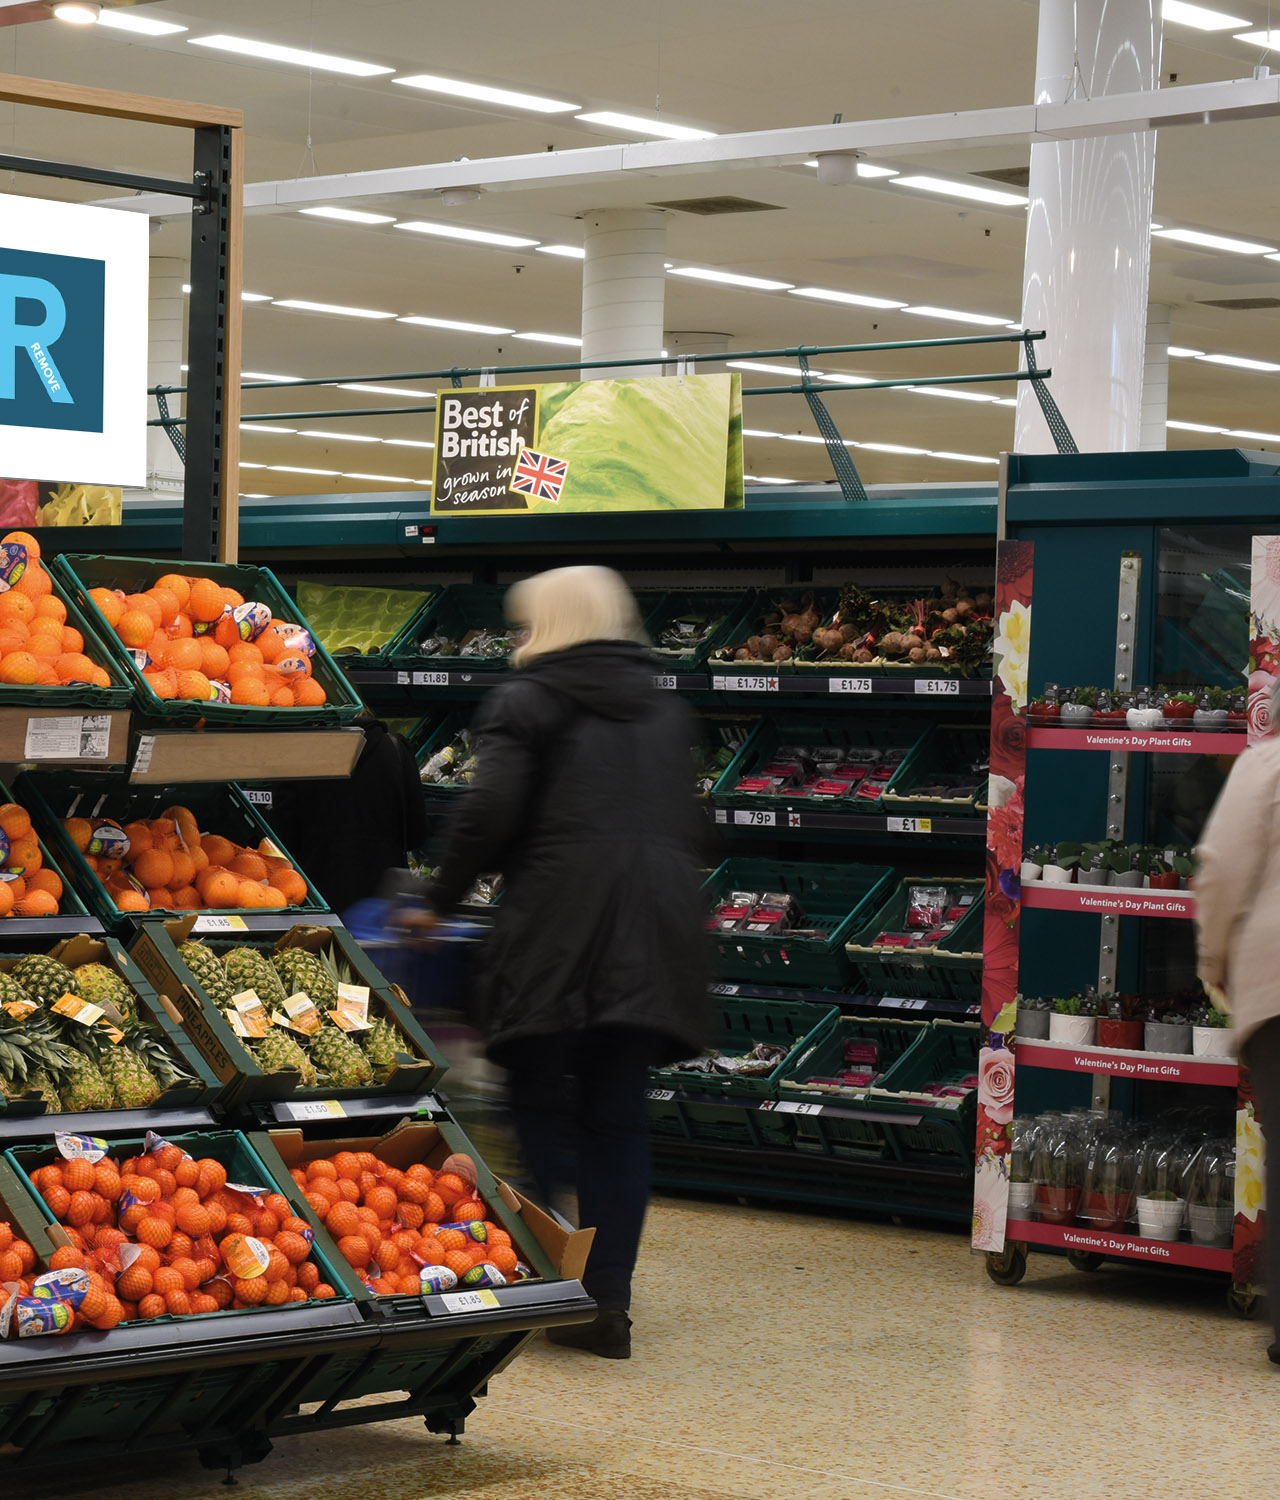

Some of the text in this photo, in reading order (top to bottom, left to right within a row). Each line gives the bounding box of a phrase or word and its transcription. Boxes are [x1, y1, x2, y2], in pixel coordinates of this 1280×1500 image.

[30, 341, 61, 393] REMOVE
[443, 397, 530, 429] Best of
[442, 428, 526, 458] British
[437, 465, 512, 502] grown in
[453, 485, 507, 505] season
[423, 673, 447, 683] £1.89
[654, 677, 675, 687] 1.85
[737, 678, 765, 688] £1.75
[841, 680, 870, 691] £1.75
[927, 681, 957, 692] £1.75
[1086, 735, 1192, 747] Valentine's Day Plant Gifts
[249, 792, 271, 802] £1.10
[749, 812, 771, 824] 79p
[902, 818, 916, 831] £1
[1080, 897, 1186, 912] Valentine's Day Plant Gifts
[206, 918, 231, 927] £1.85
[900, 999, 916, 1009] £1
[177, 994, 228, 1069] PINEAPPLES
[1074, 1056, 1181, 1076] Valentine's Day Plant Gifts
[304, 1104, 328, 1114] £1.50
[795, 1103, 812, 1113] £1
[1063, 1232, 1170, 1257] Valentine's Day Plant Gifts
[458, 1294, 482, 1306] £1.85
